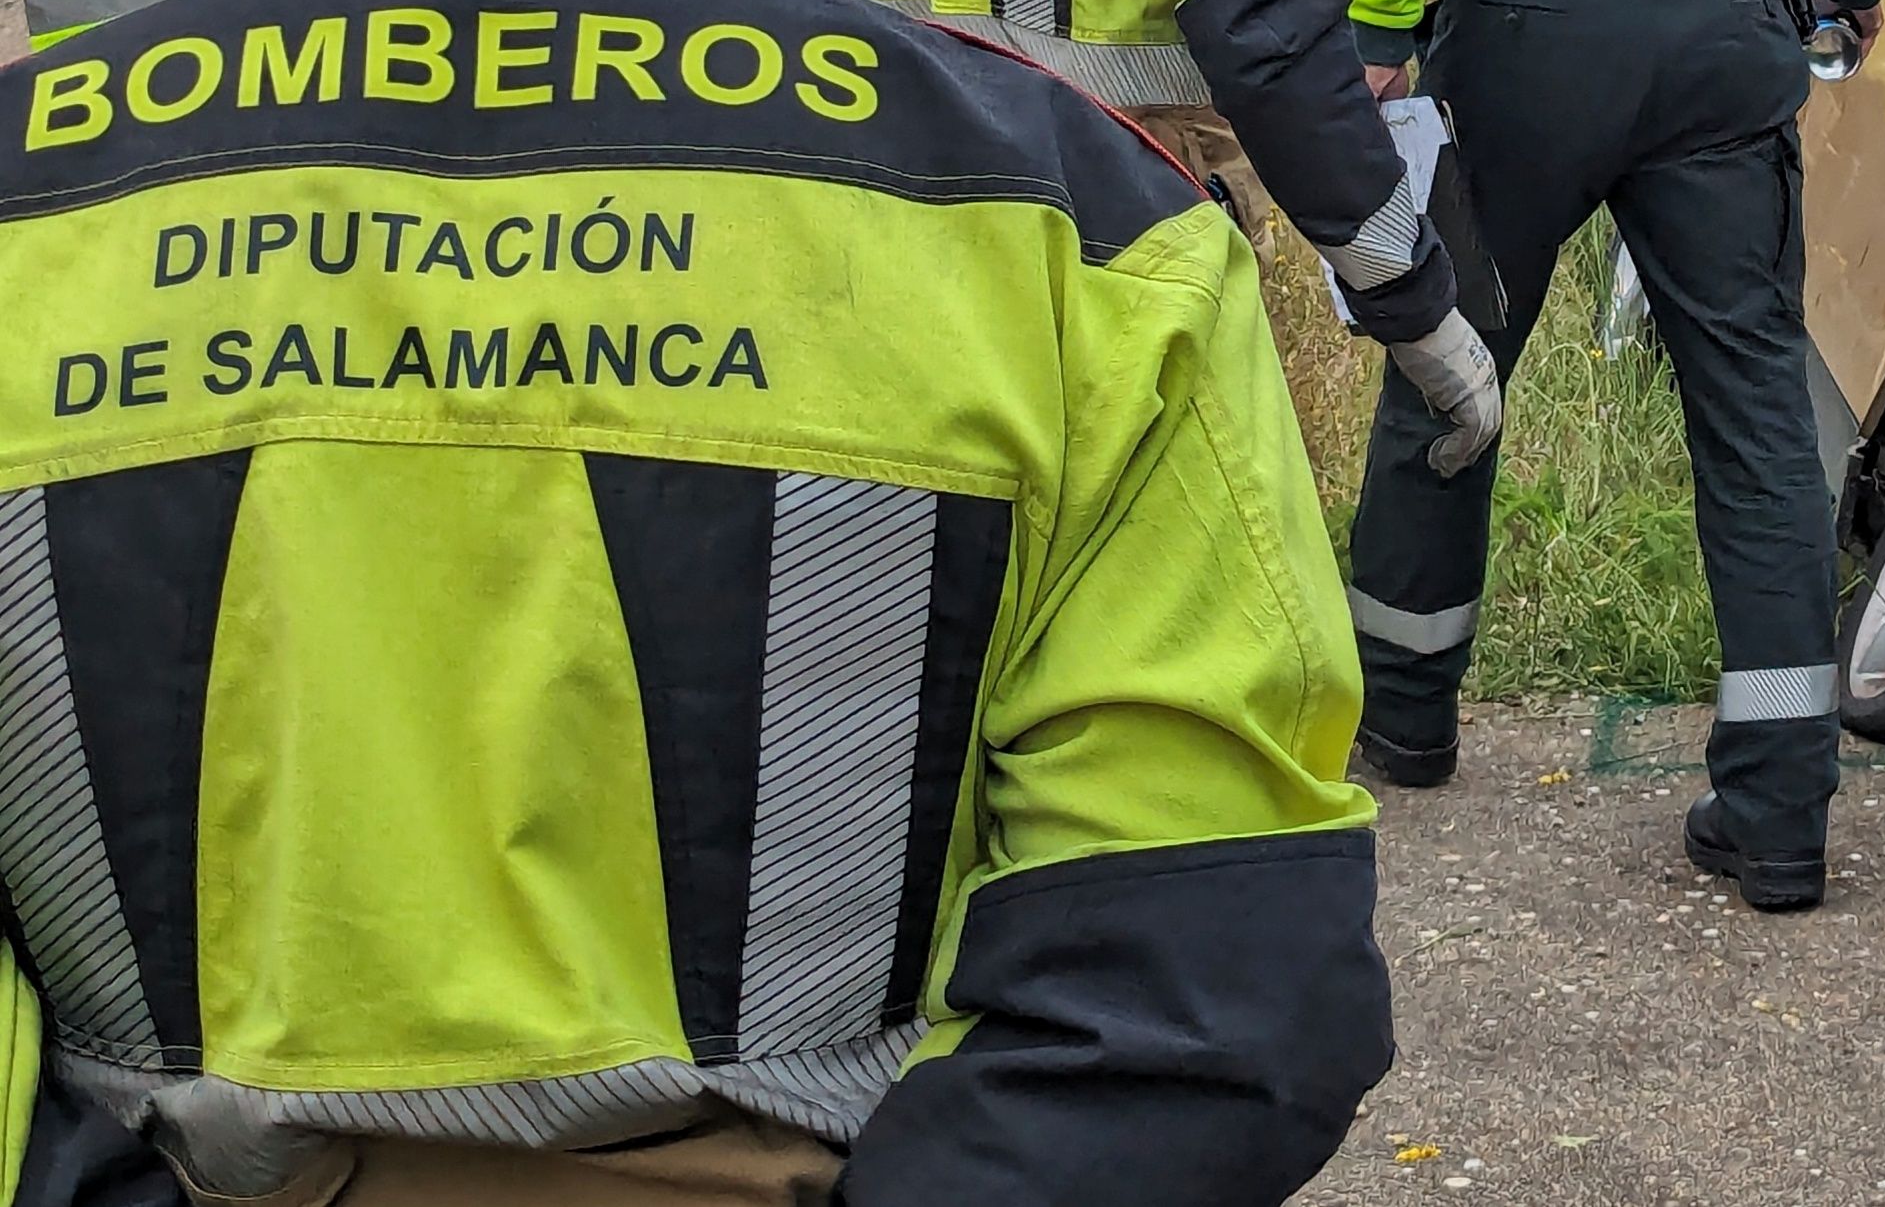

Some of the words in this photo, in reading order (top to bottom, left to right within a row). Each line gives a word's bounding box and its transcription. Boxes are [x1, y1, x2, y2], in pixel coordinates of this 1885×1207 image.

[24, 8, 880, 152] BOMBEROS
[152, 196, 696, 289] DIPUTACIÓN
[53, 339, 171, 417] DE
[202, 322, 770, 391] SALAMANCA
